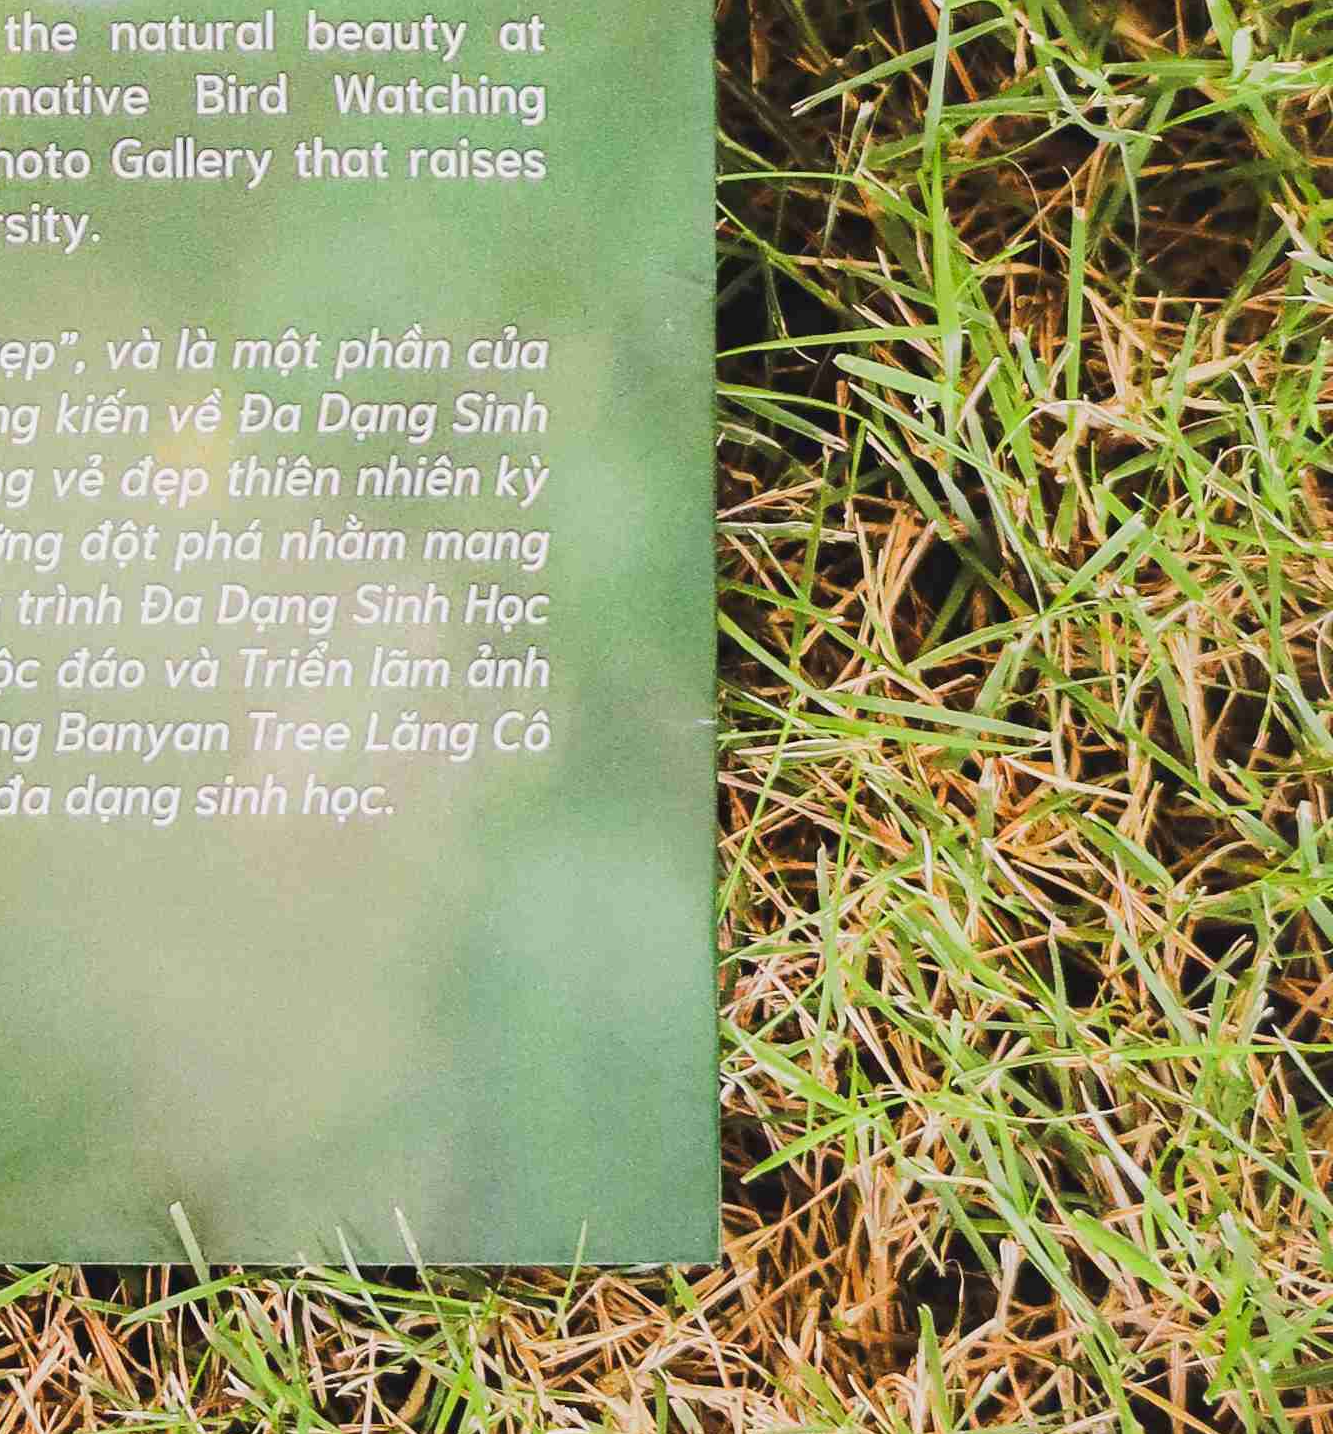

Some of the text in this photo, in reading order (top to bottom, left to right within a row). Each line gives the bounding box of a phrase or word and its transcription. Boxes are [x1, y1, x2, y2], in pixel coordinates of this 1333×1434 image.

[2, 11, 79, 55] the
[108, 9, 276, 55] natural
[306, 8, 468, 64] beauty
[497, 14, 547, 56] at
[194, 73, 289, 117] Bird
[332, 72, 547, 129] Watching
[110, 136, 274, 192] Gallery
[292, 136, 390, 182] that
[406, 136, 548, 184] raises
[104, 324, 162, 372] và
[175, 326, 218, 373] là
[230, 326, 323, 378] một
[332, 322, 452, 384] phần
[465, 324, 551, 374] của
[54, 387, 151, 438] kiến
[166, 386, 224, 438] về
[237, 392, 303, 438] Đa
[315, 389, 439, 447] Dạng
[451, 390, 550, 437] Sinh
[51, 452, 106, 502] vẻ
[117, 454, 210, 511] đẹp
[226, 454, 342, 501] thiên
[355, 449, 482, 500] nhiên
[494, 453, 551, 510] kỳ
[78, 518, 161, 570] đột
[170, 513, 264, 575] phá
[278, 512, 407, 564] nhằm
[422, 530, 553, 574] mang
[17, 576, 123, 627] trình
[138, 579, 205, 627] Đa
[215, 583, 340, 637] Dạng
[351, 582, 452, 626] Sinh
[463, 578, 552, 635] Học
[54, 645, 147, 691] đáo
[163, 645, 221, 690] và
[238, 632, 355, 690] Triển
[367, 645, 452, 690] lãm
[463, 642, 552, 690] ảnh
[53, 710, 231, 764] Banyan
[363, 710, 480, 763] Lăng
[491, 708, 553, 753] Cô
[63, 770, 183, 828] dạng
[194, 772, 289, 818] sinh
[299, 771, 396, 827] học.
